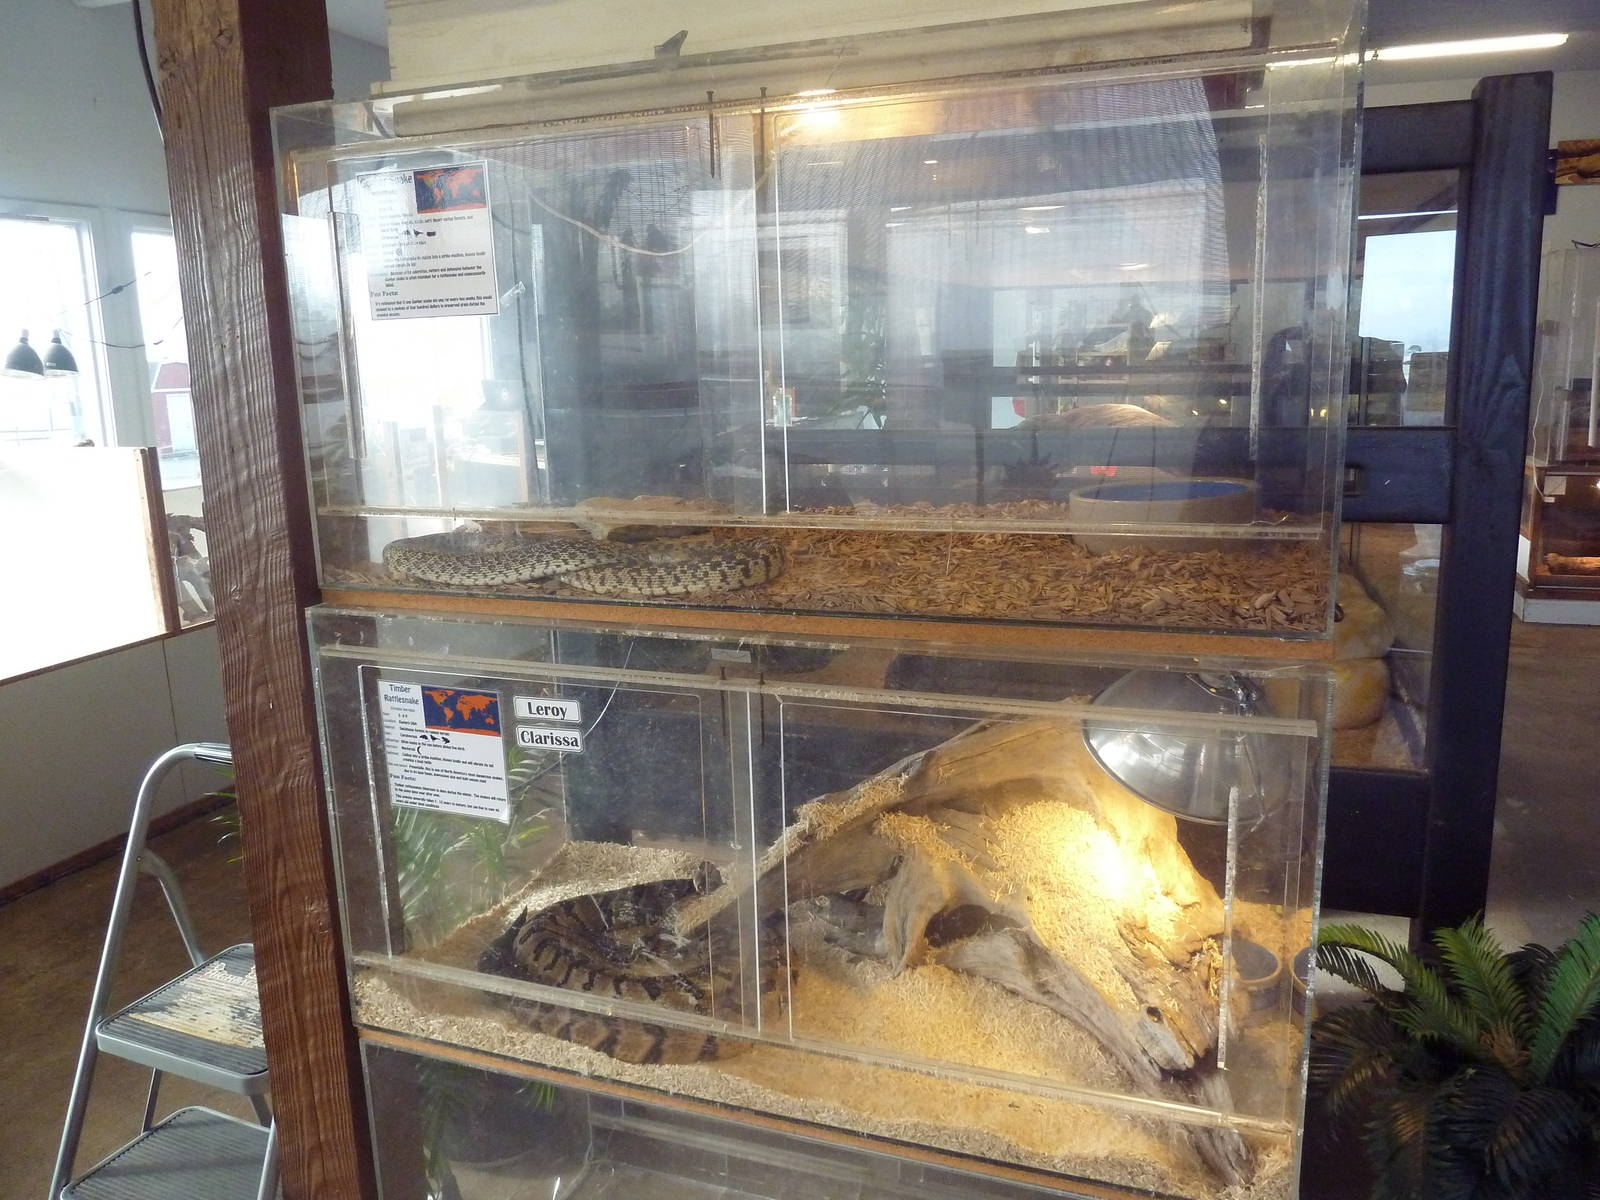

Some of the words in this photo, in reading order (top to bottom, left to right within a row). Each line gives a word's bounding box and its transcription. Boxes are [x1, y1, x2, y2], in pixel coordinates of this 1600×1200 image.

[389, 684, 411, 693] Timber
[384, 694, 420, 705] Rattlesnake
[528, 702, 567, 720] Leroy
[520, 730, 580, 748] Clarissa
